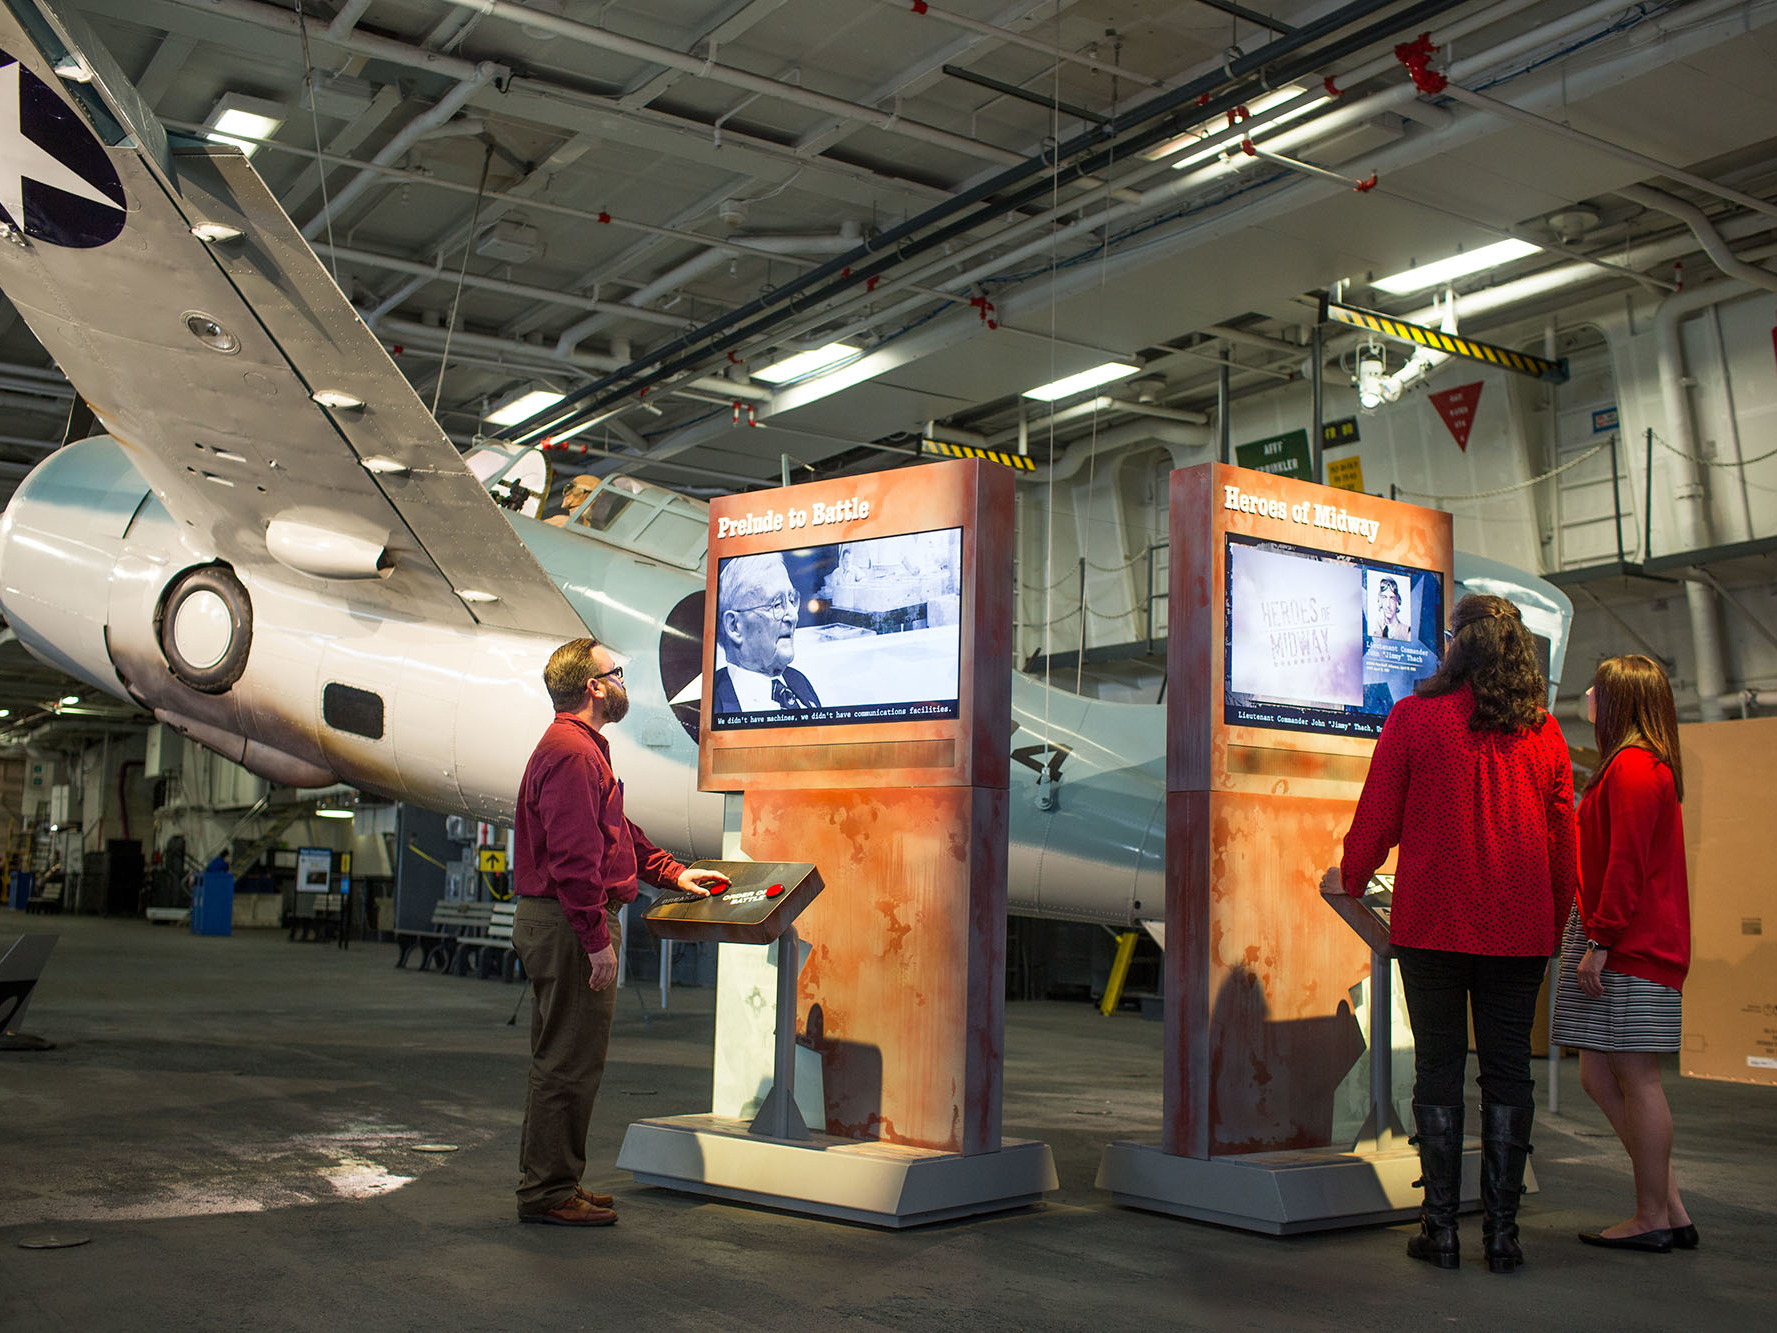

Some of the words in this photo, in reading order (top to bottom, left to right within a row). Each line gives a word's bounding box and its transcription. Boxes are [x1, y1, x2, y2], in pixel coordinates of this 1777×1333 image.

[717, 510, 784, 539] Prelude
[788, 507, 807, 529] to
[812, 497, 870, 526] Battle
[1224, 485, 1287, 520] Heroes
[1292, 501, 1311, 524] of
[1313, 503, 1380, 544] Midway
[1261, 597, 1318, 628] HEROES
[1270, 628, 1330, 659] MIDWAY
[717, 717, 725, 725] We
[728, 715, 748, 724] didn't
[750, 715, 765, 723] have
[811, 711, 834, 719] didn't
[835, 710, 852, 718] have
[853, 707, 907, 718] communications
[909, 705, 952, 715] facilities.
[1238, 711, 1274, 722] Lieutenant
[1277, 714, 1309, 726] Commander
[1311, 718, 1326, 727] John
[722, 891, 755, 901] ORDER
[730, 894, 767, 905] BATTLE
